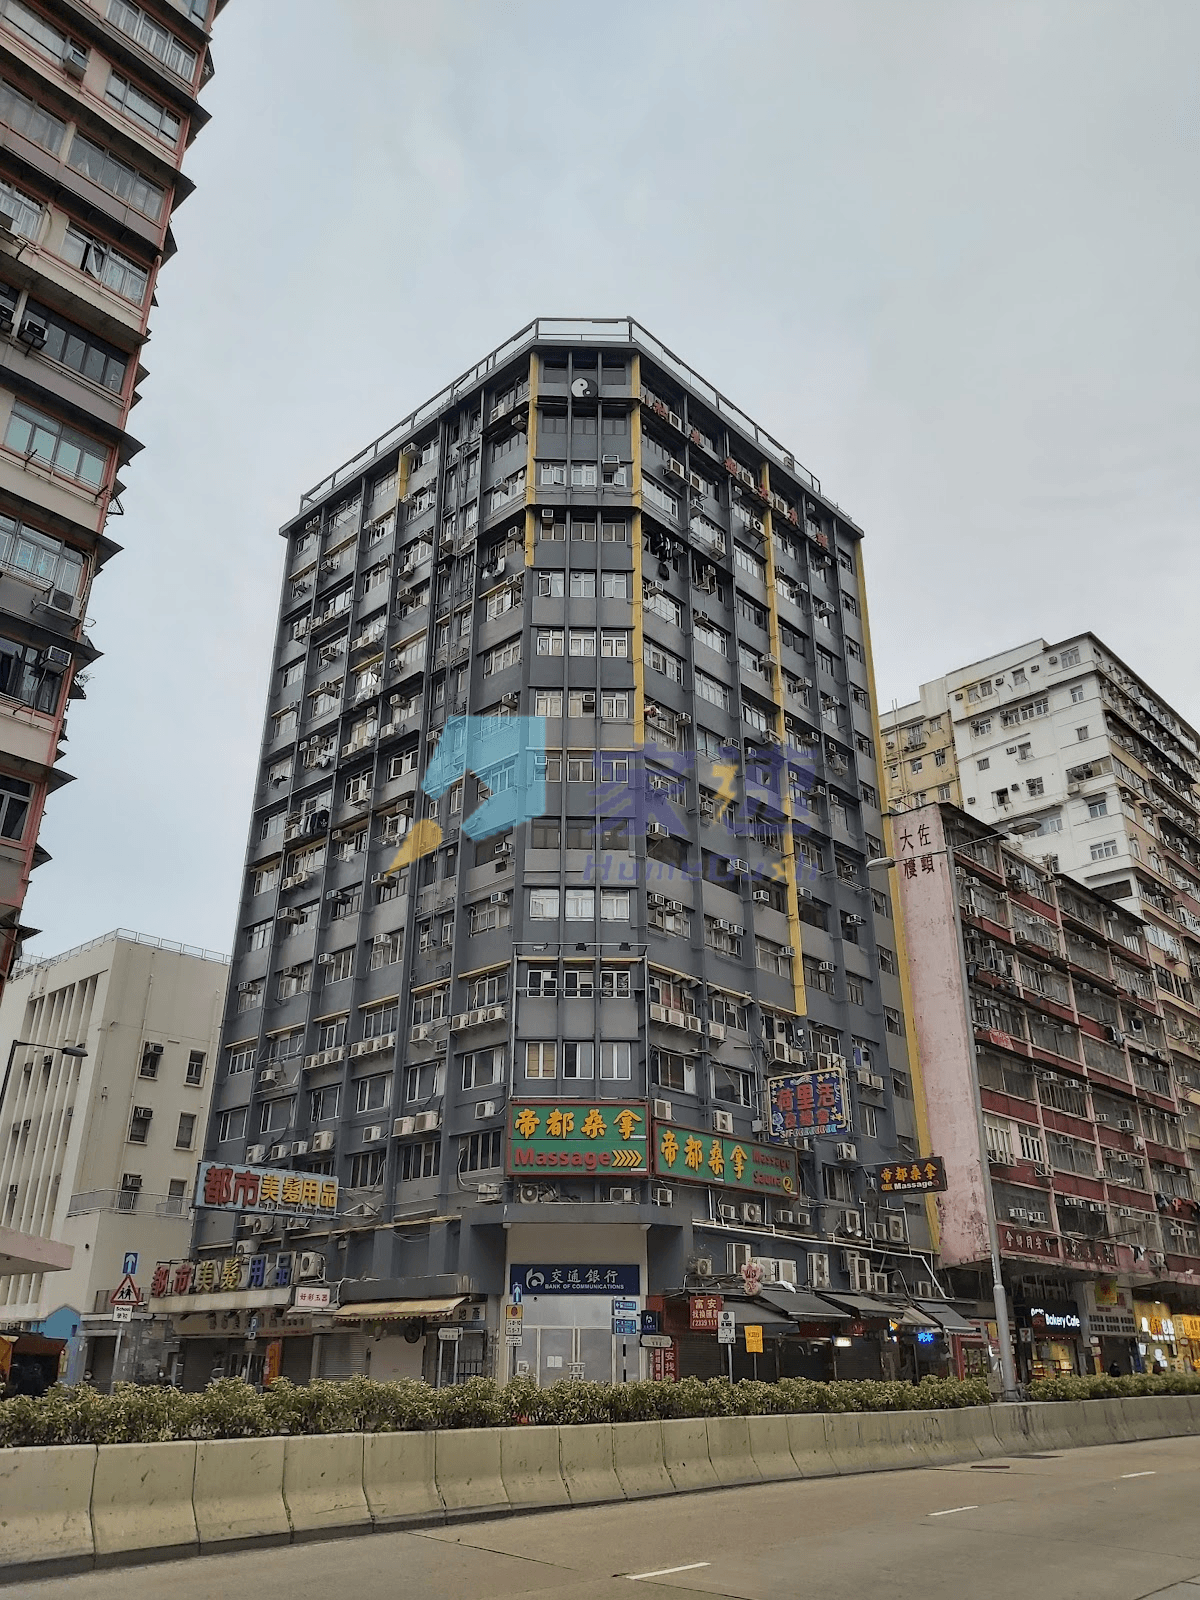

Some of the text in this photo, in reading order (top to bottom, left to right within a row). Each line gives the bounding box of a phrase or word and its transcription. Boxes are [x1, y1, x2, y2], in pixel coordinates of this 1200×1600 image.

[777, 1083, 835, 1111] 荷里活
[514, 1108, 642, 1139] 帝都桑拿
[515, 1147, 611, 1170] Massage
[660, 1130, 748, 1180] 帝都桑拿
[752, 1151, 791, 1170] Massage
[753, 1171, 782, 1186] Sauna
[881, 1162, 937, 1183] 帝都桑拿
[205, 1165, 336, 1208] 都市美髮用品
[894, 1181, 933, 1191] Massage
[550, 1268, 618, 1283] 交通銀行
[694, 1299, 718, 1310] 富安
[1045, 1313, 1066, 1328] Bakery
[1066, 1314, 1080, 1327] Cafe
